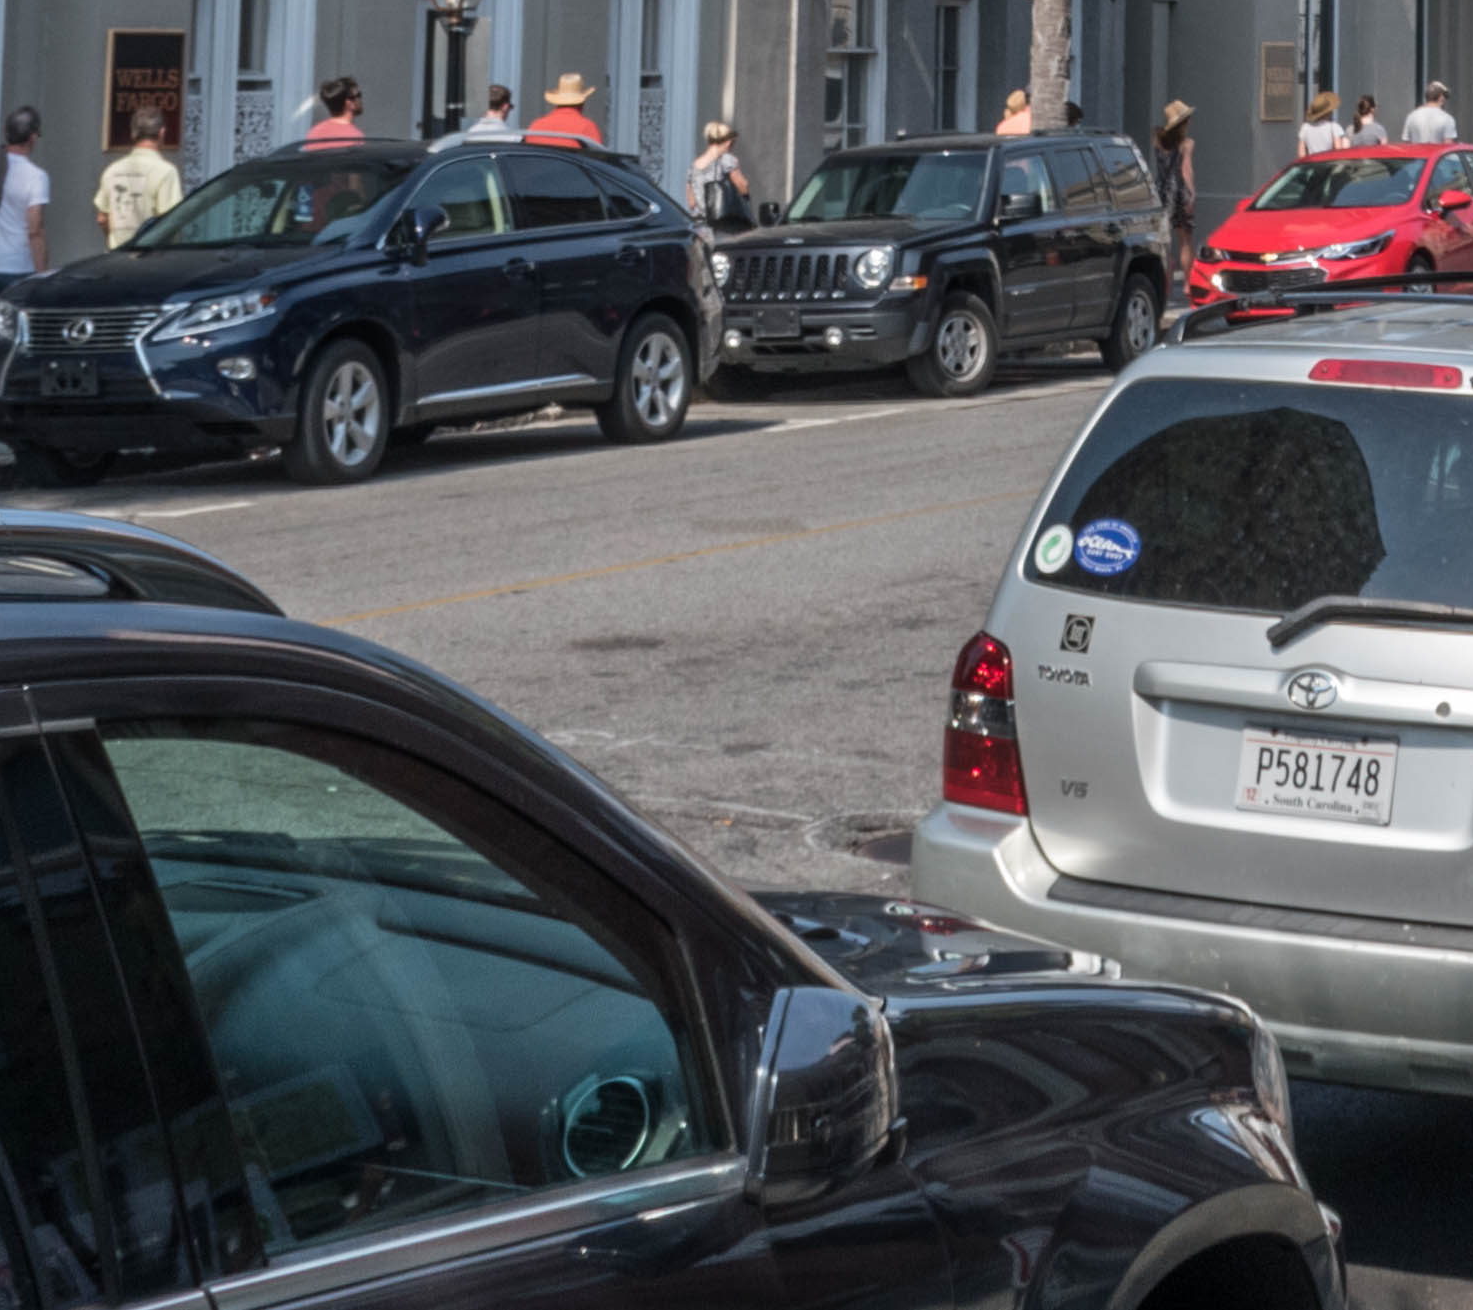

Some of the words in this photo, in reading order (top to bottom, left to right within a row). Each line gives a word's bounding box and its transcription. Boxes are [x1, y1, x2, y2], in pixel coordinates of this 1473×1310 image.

[116, 68, 181, 89] WELLS
[116, 91, 179, 112] FARGO
[1038, 663, 1091, 687] TOYOTA
[1255, 746, 1382, 797] P581748
[1060, 778, 1089, 799] V6
[1273, 793, 1304, 808] South
[1307, 798, 1353, 814] Carolina
